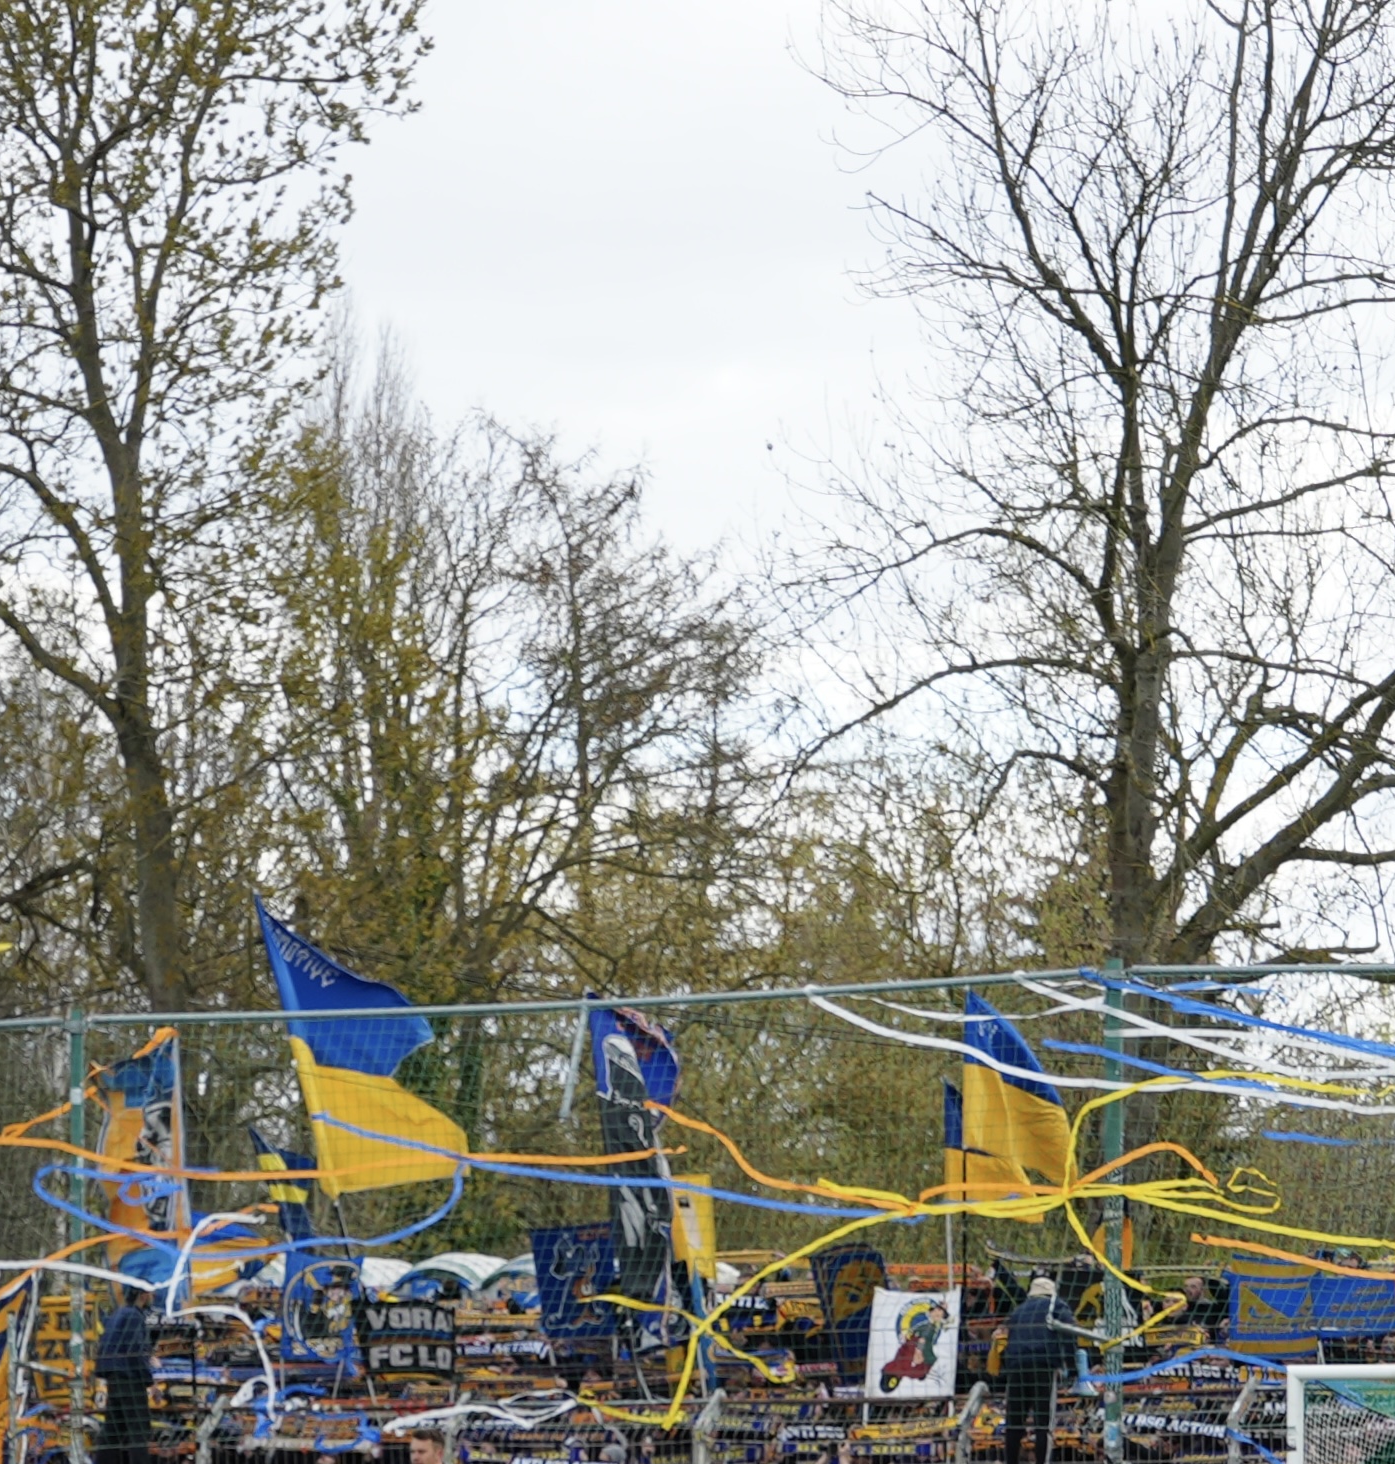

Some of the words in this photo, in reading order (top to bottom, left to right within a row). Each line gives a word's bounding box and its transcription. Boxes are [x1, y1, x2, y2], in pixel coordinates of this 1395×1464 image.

[369, 1344, 414, 1369] FC
[1135, 1413, 1166, 1429] BSG
[1167, 1420, 1227, 1438] ACTION
